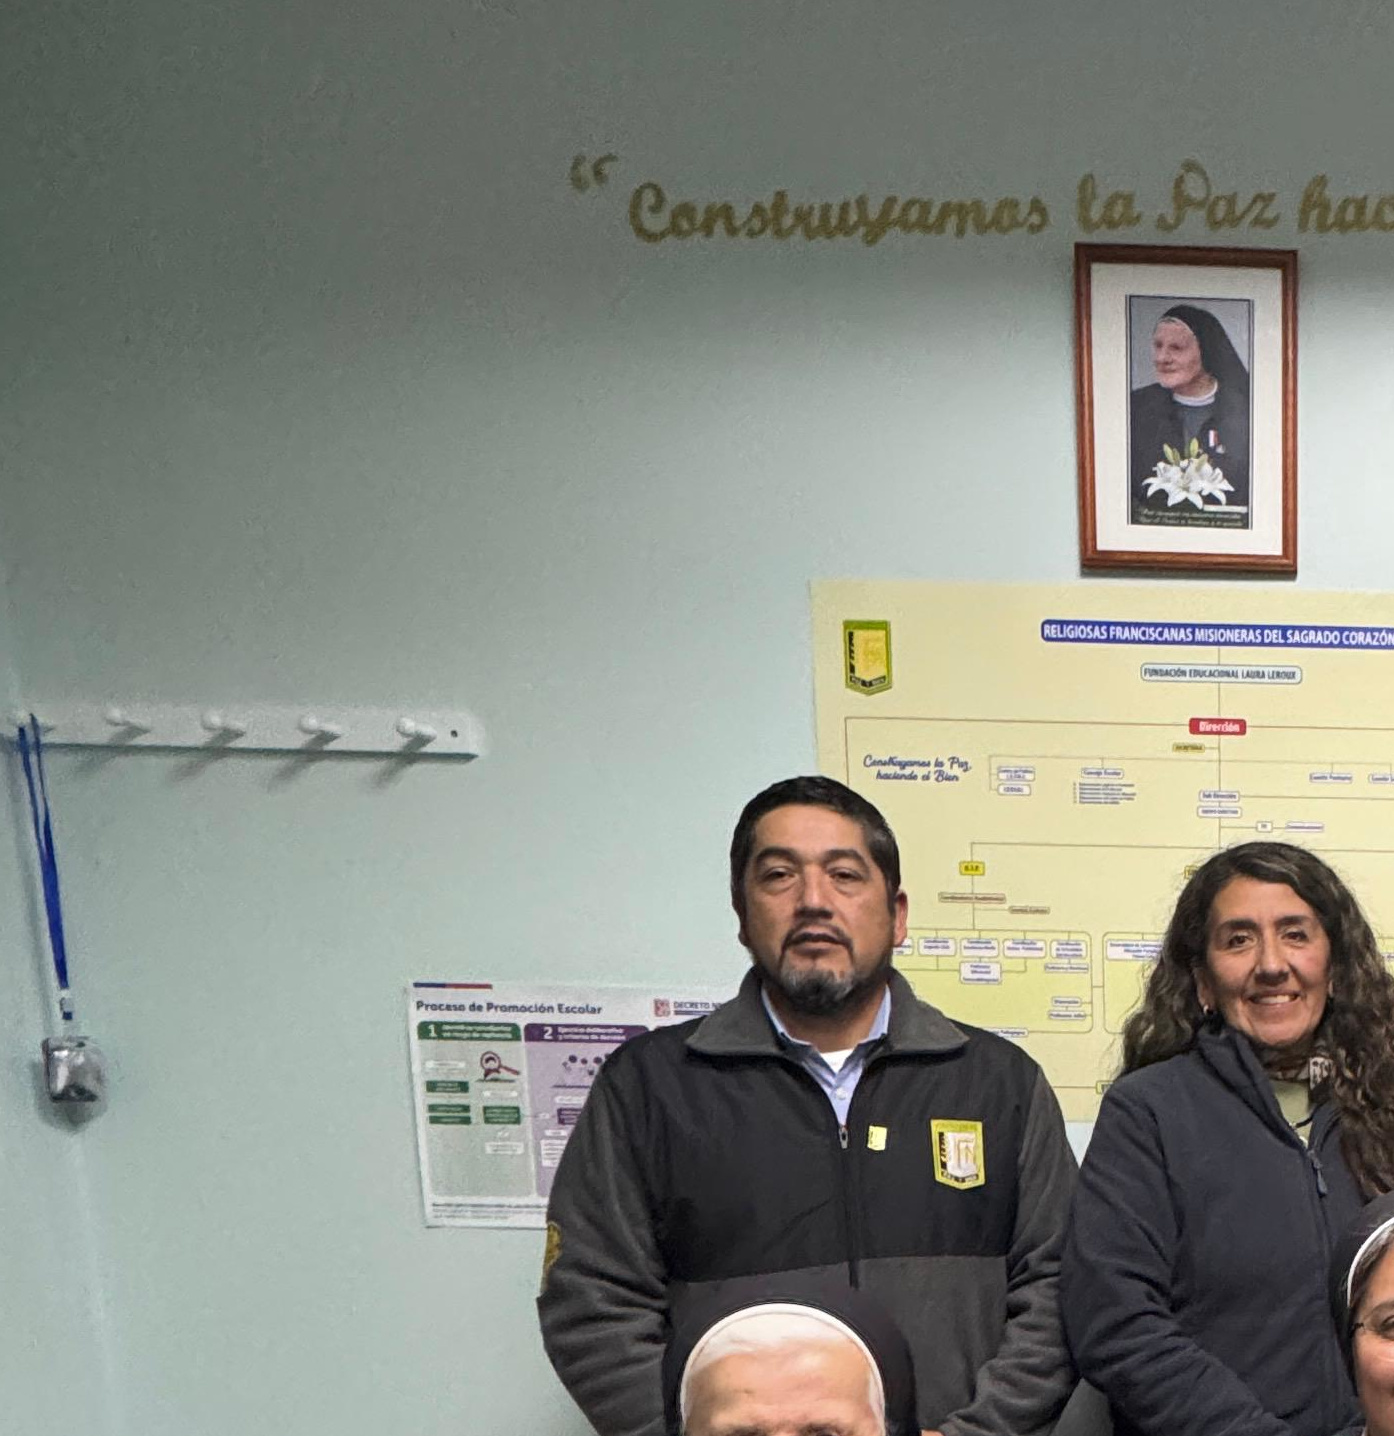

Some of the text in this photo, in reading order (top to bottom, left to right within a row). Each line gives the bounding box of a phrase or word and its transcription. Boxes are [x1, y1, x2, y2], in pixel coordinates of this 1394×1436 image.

[1076, 173, 1141, 234] la
[1154, 159, 1282, 234] Paz
[1043, 624, 1107, 640] RELIGIOSAS
[1109, 626, 1192, 642] FRANCISCANAS
[1194, 628, 1261, 644] MISIONERAS
[1264, 629, 1285, 644] DEL
[1286, 630, 1340, 645] SAGRADO
[1143, 667, 1296, 680] FUNDACIÓN EDUCACIONAL LAURA LEROUX
[1199, 721, 1240, 733] Dirección
[416, 1001, 602, 1014] Proceso de Promoción Escolar
[673, 1001, 710, 1009] DECRETO
[428, 1024, 437, 1038] 1
[543, 1026, 553, 1039] 2
